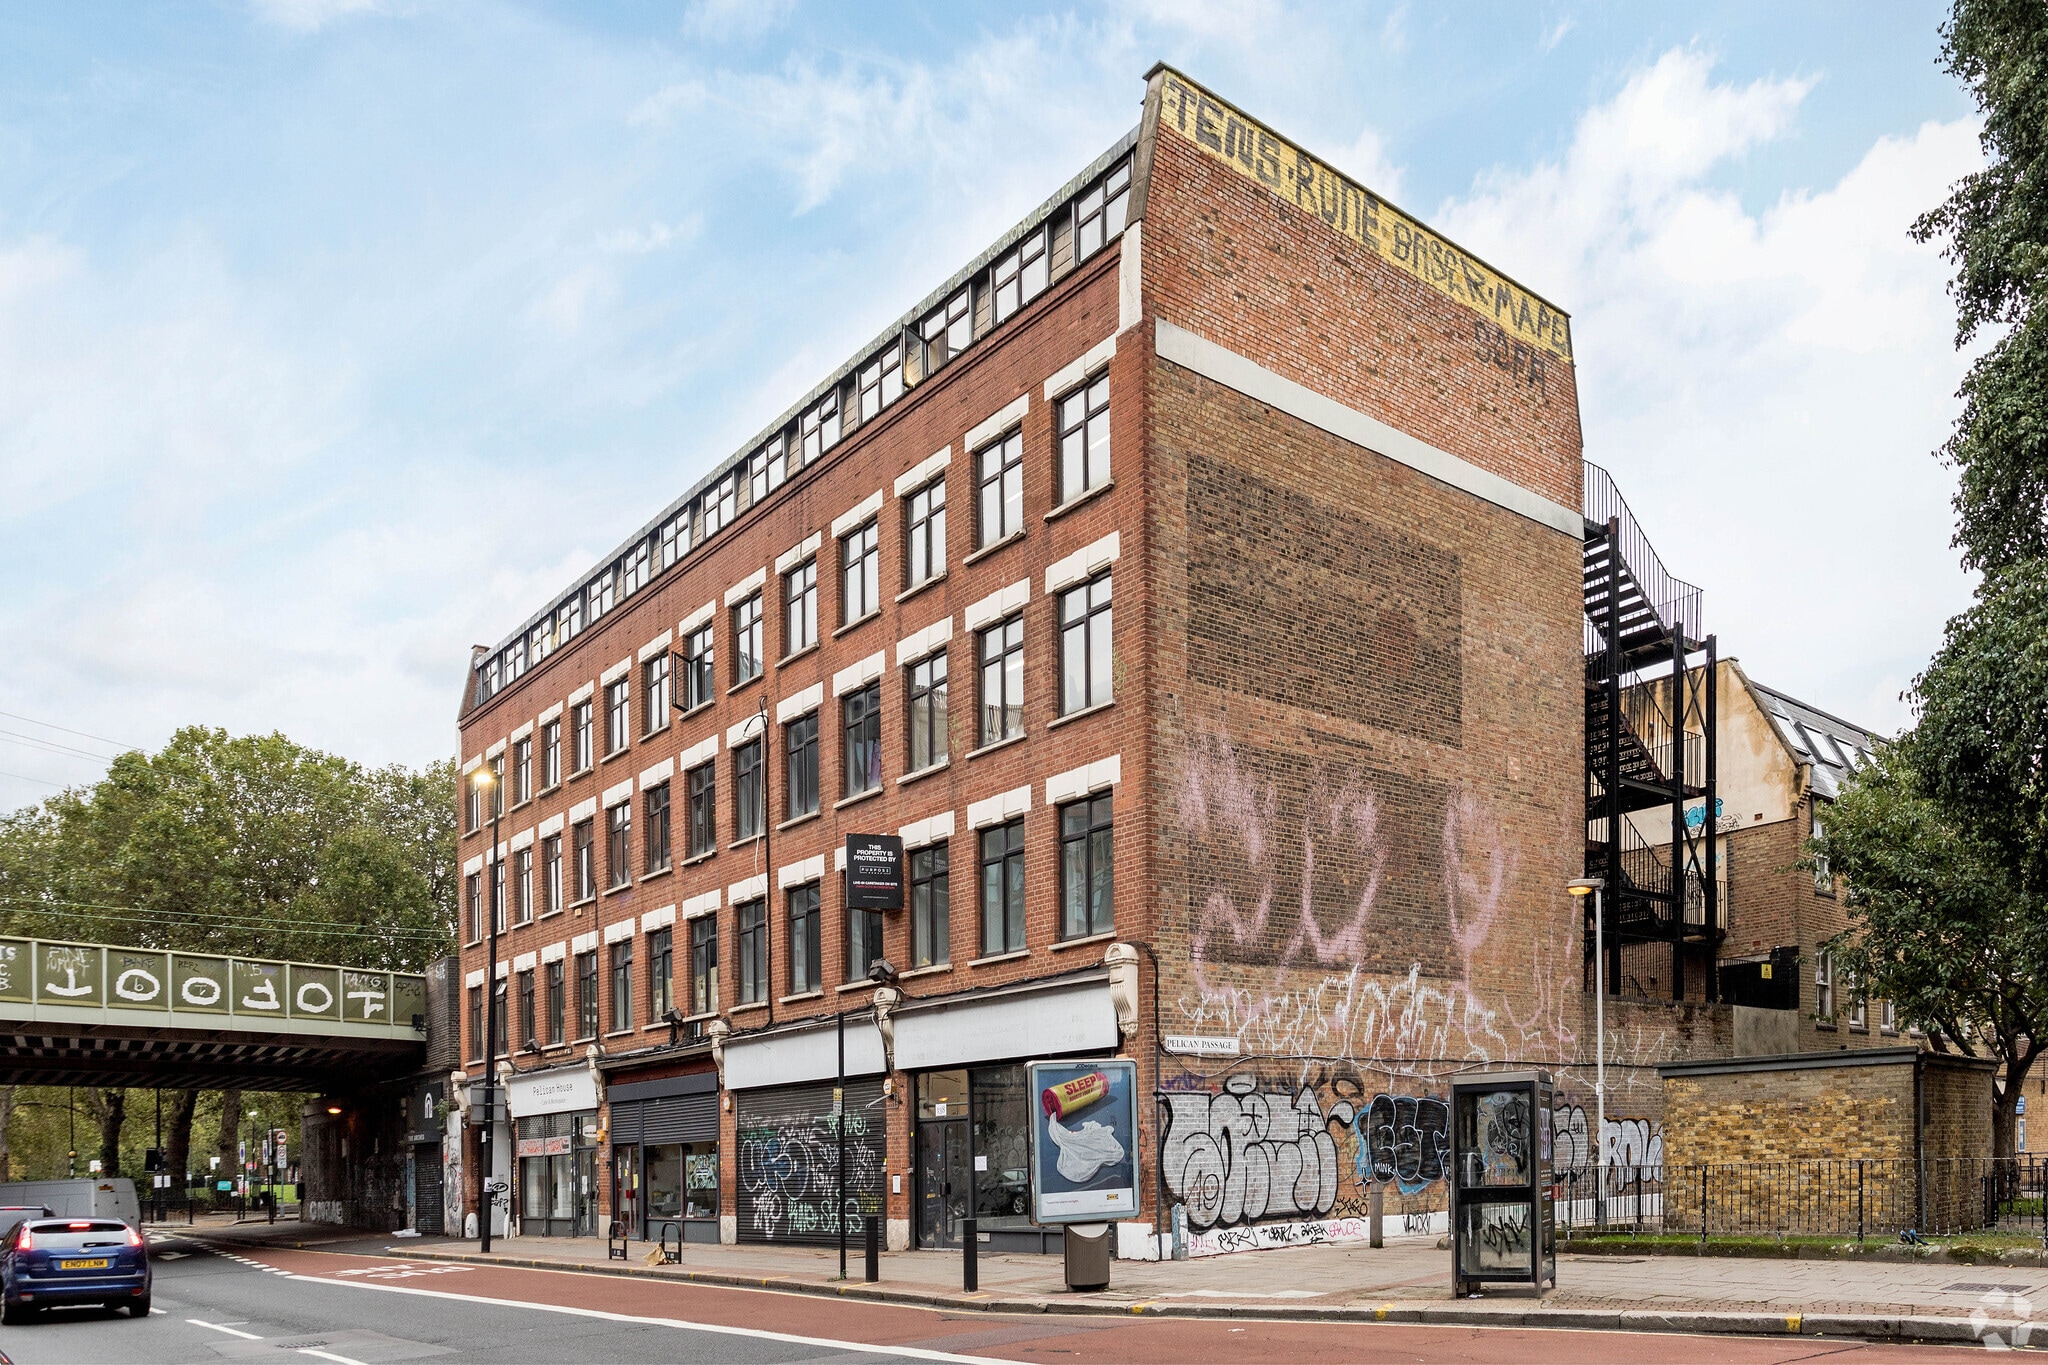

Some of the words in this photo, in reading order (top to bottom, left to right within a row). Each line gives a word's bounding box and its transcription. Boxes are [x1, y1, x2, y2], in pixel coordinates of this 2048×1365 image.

[1166, 1039, 1200, 1048] PELICAN
[1201, 1040, 1233, 1050] PASSAGE
[532, 1086, 555, 1096] Pelican
[556, 1084, 573, 1092] House
[1064, 1075, 1097, 1096] SLEEP
[1374, 1162, 1395, 1176] MINK
[65, 1260, 87, 1268] EN07
